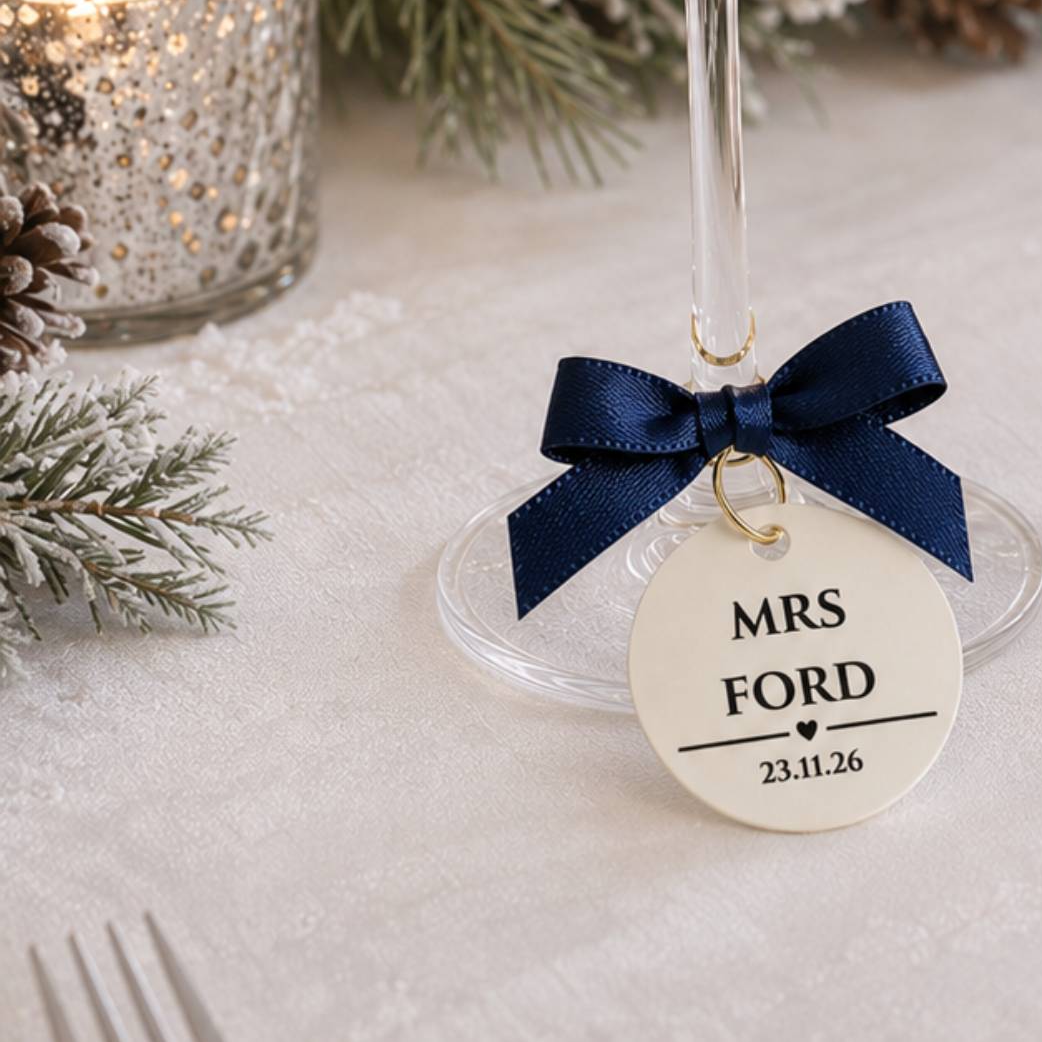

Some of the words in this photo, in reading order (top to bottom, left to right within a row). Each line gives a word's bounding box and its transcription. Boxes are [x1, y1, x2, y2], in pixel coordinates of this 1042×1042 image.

[732, 588, 846, 641] MRS
[721, 660, 876, 717] FORD
[759, 748, 864, 785] 23.11.26
